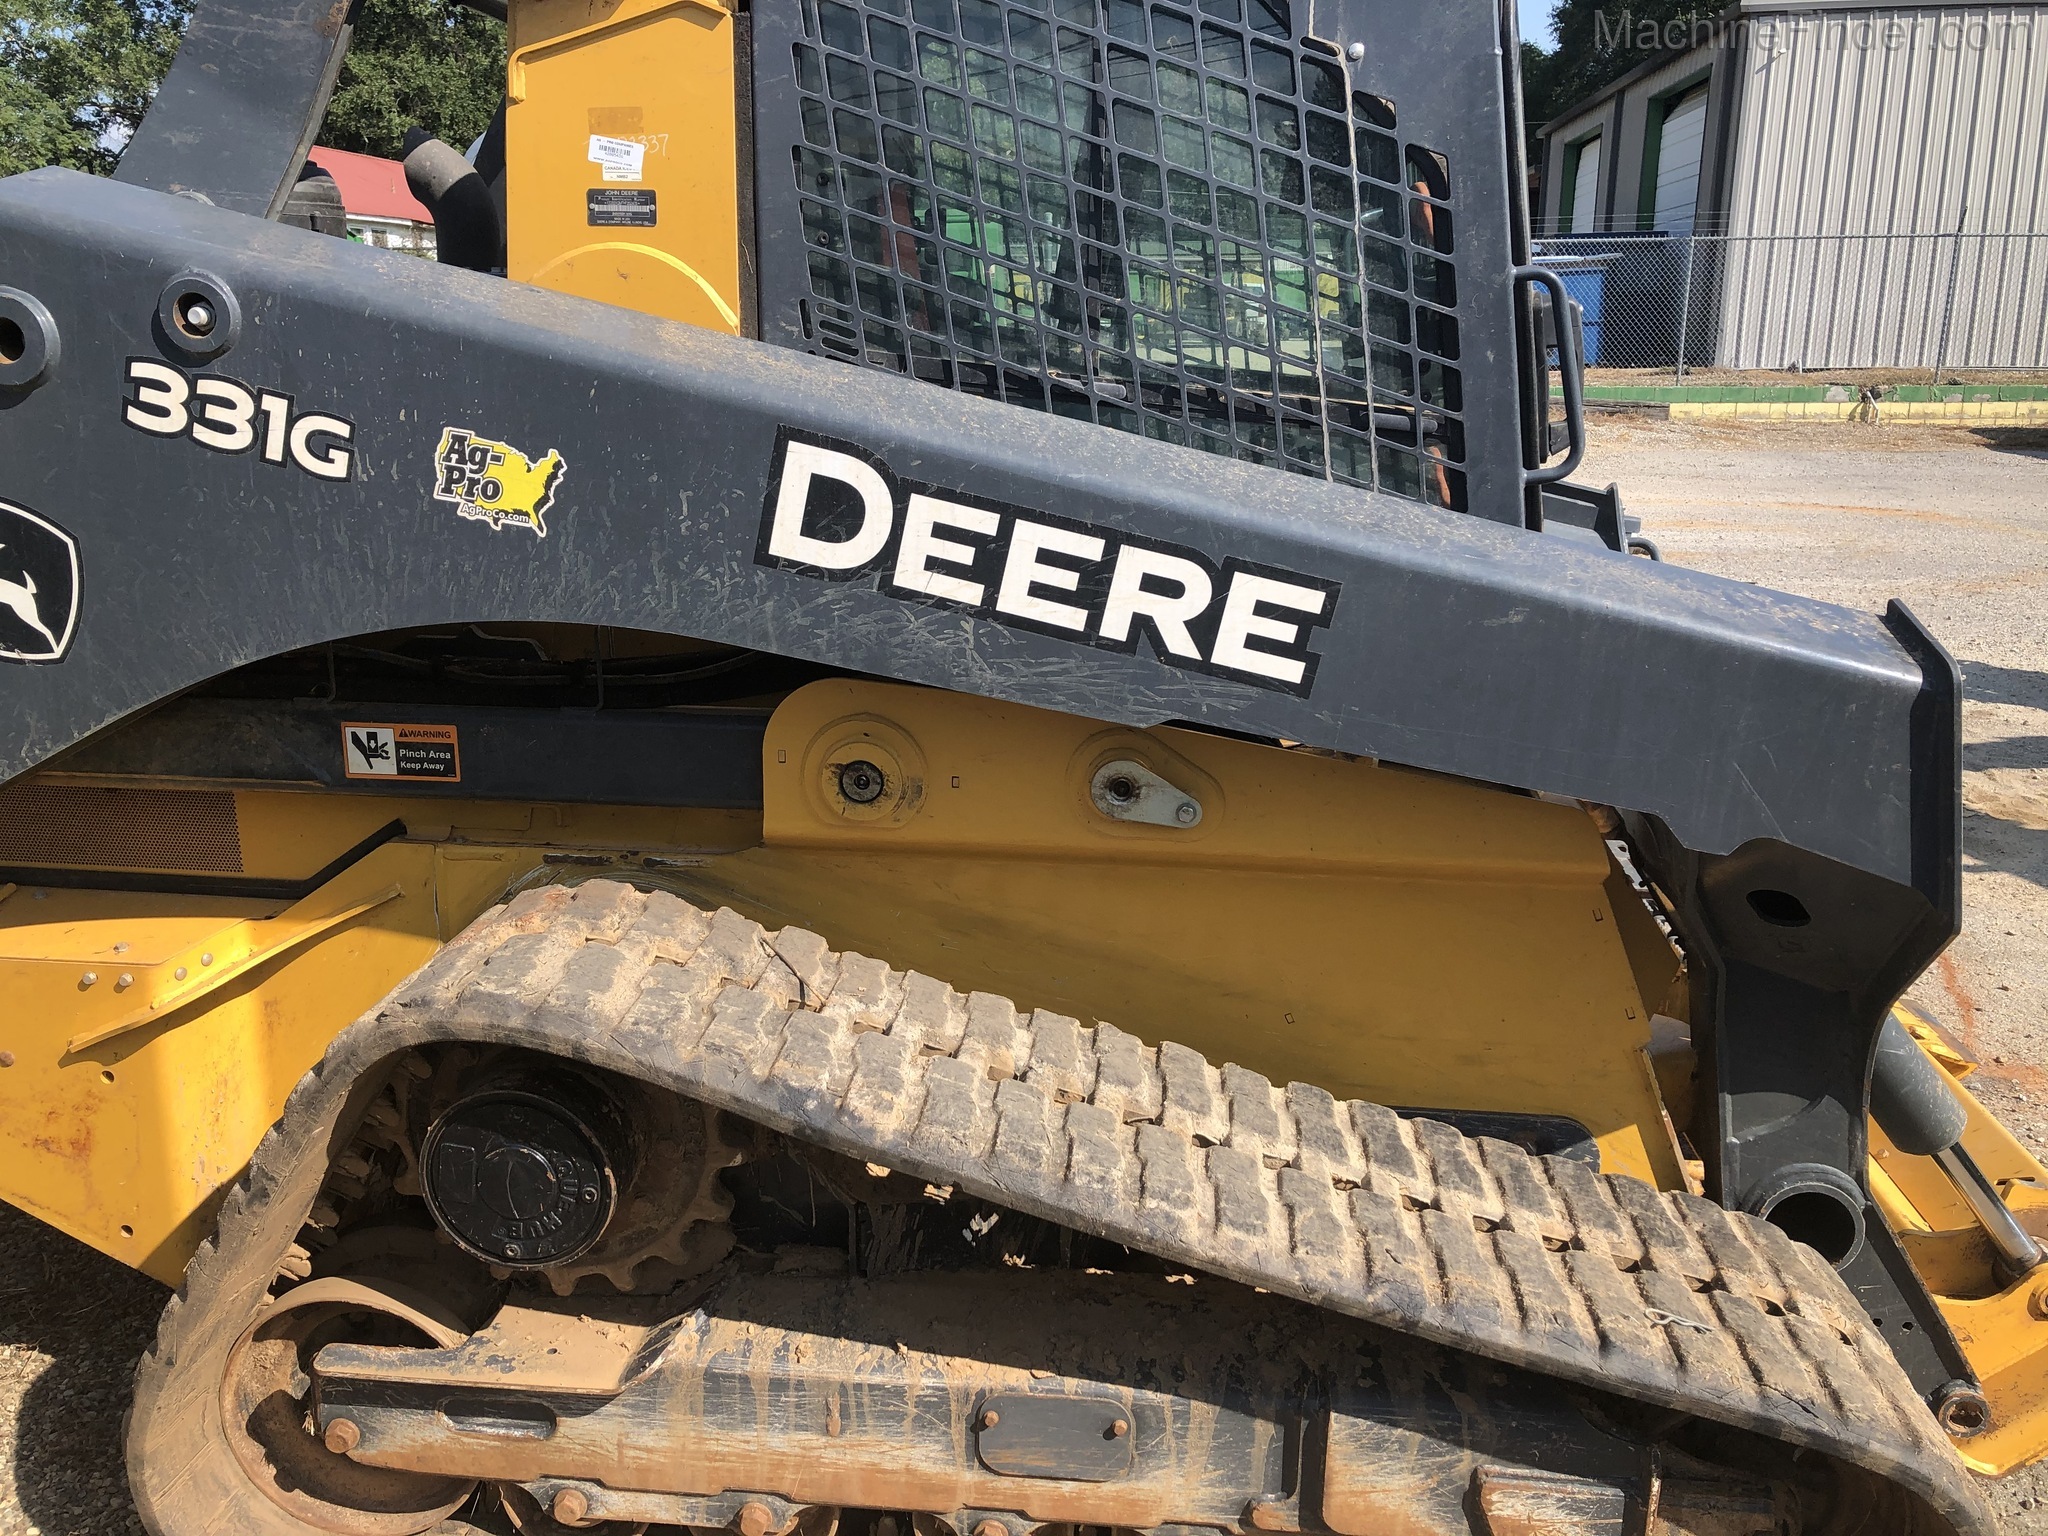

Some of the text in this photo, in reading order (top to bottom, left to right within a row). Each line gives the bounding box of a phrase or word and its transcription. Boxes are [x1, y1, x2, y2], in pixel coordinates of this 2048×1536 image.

[123, 359, 353, 480] 331G
[440, 430, 505, 475] Ag-
[438, 465, 503, 503] Pro
[461, 504, 530, 523] AgProCo.com
[767, 439, 1328, 686] DEERE
[407, 730, 452, 739] WARNING
[399, 748, 451, 759] Pinch Area
[400, 761, 445, 771] Keep Away
